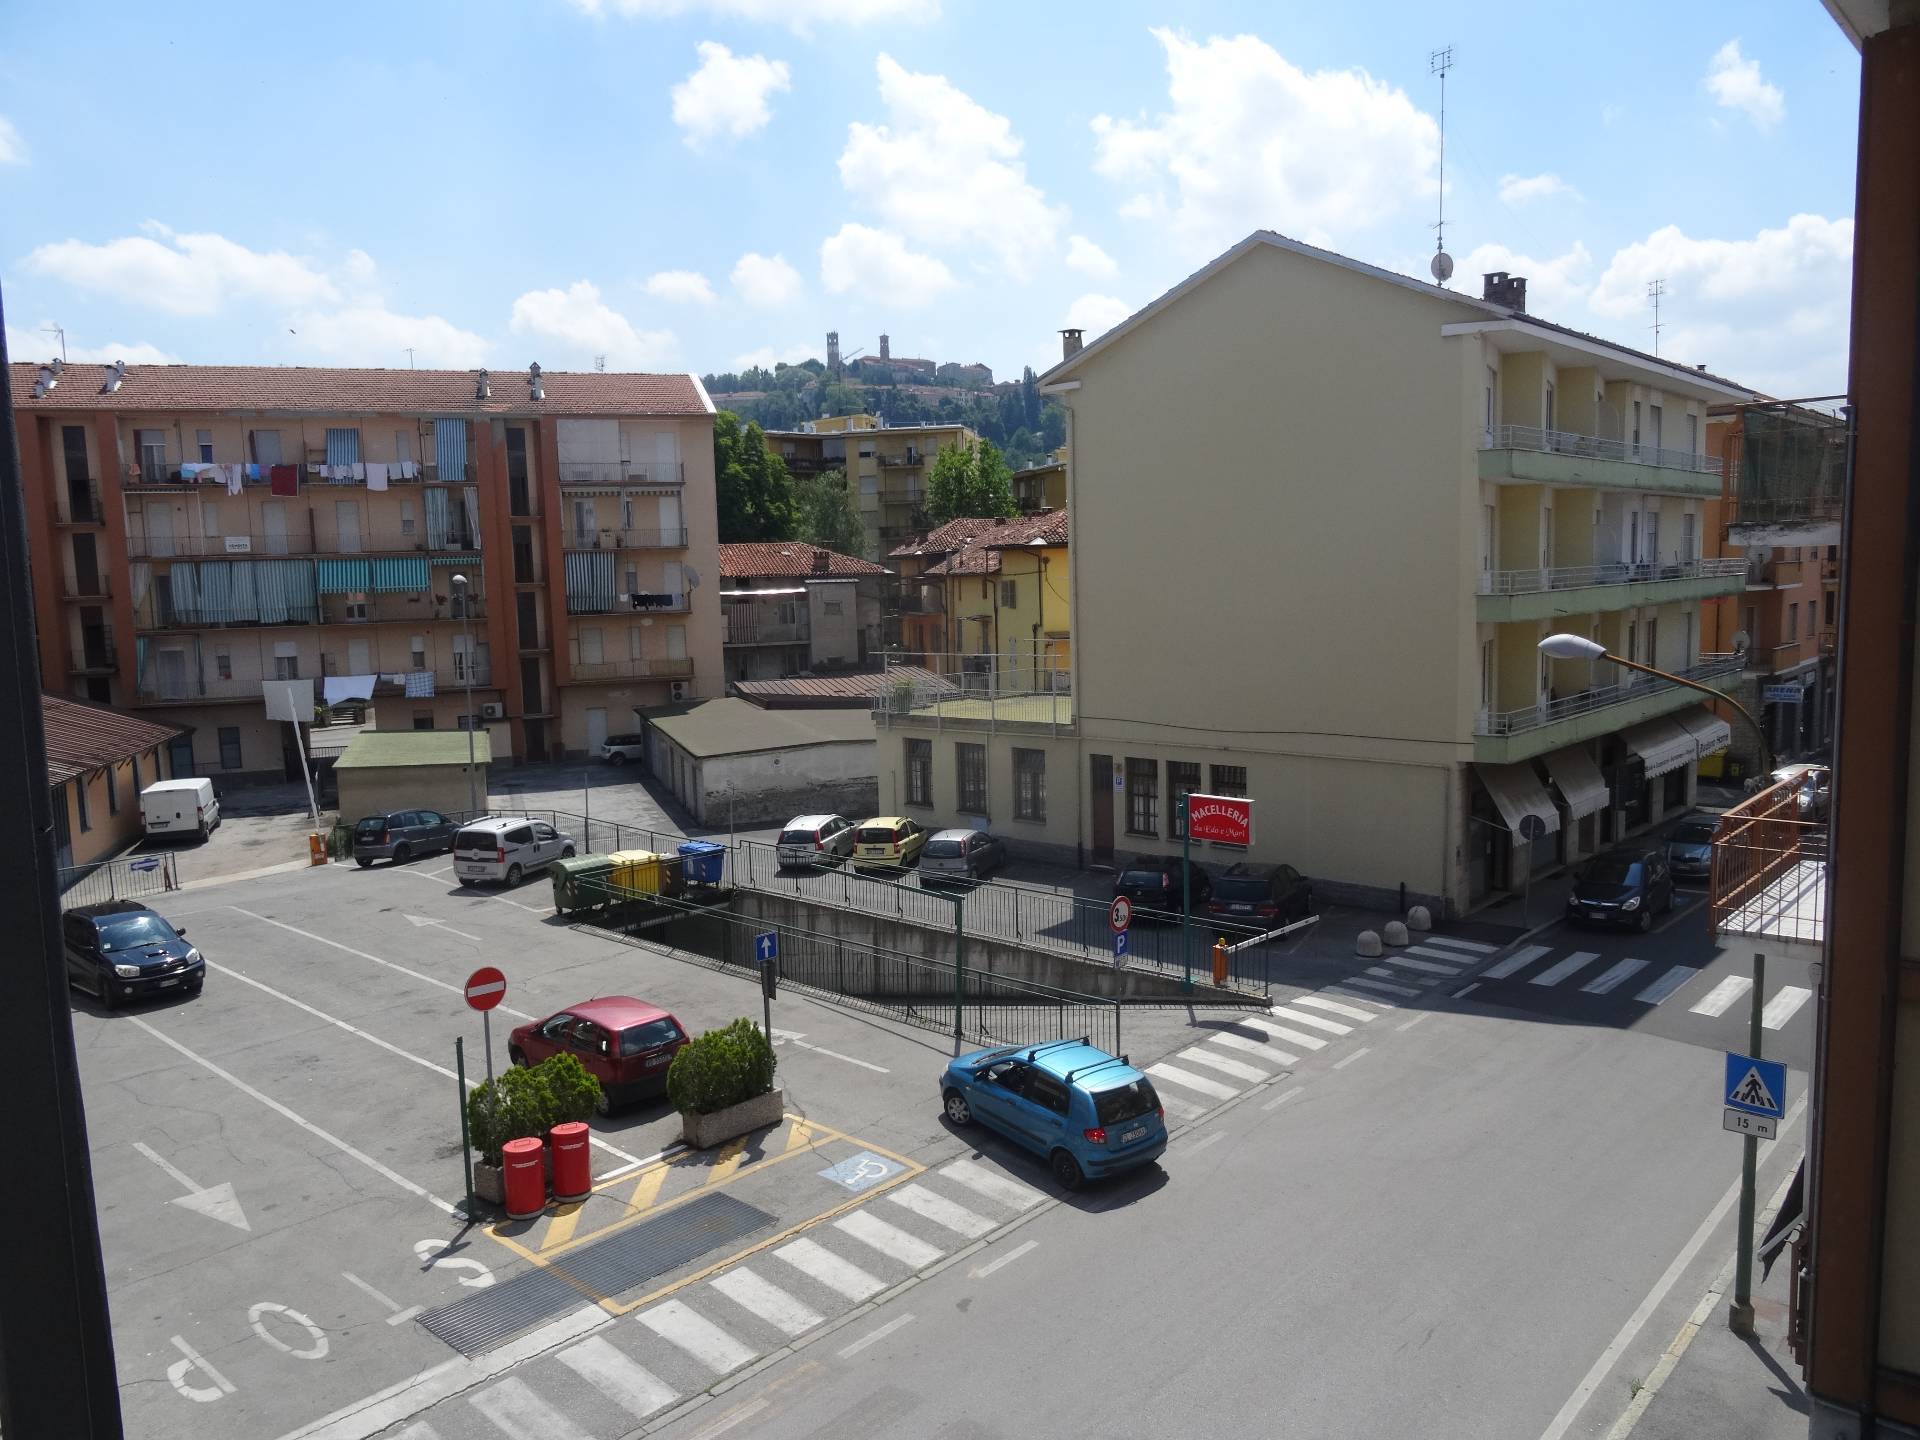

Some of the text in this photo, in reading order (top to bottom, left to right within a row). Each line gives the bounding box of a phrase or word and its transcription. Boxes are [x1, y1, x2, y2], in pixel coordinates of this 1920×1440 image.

[1191, 804, 1249, 828] MACELLERIA
[1117, 934, 1125, 954] P
[1737, 1117, 1768, 1133] 15 m
